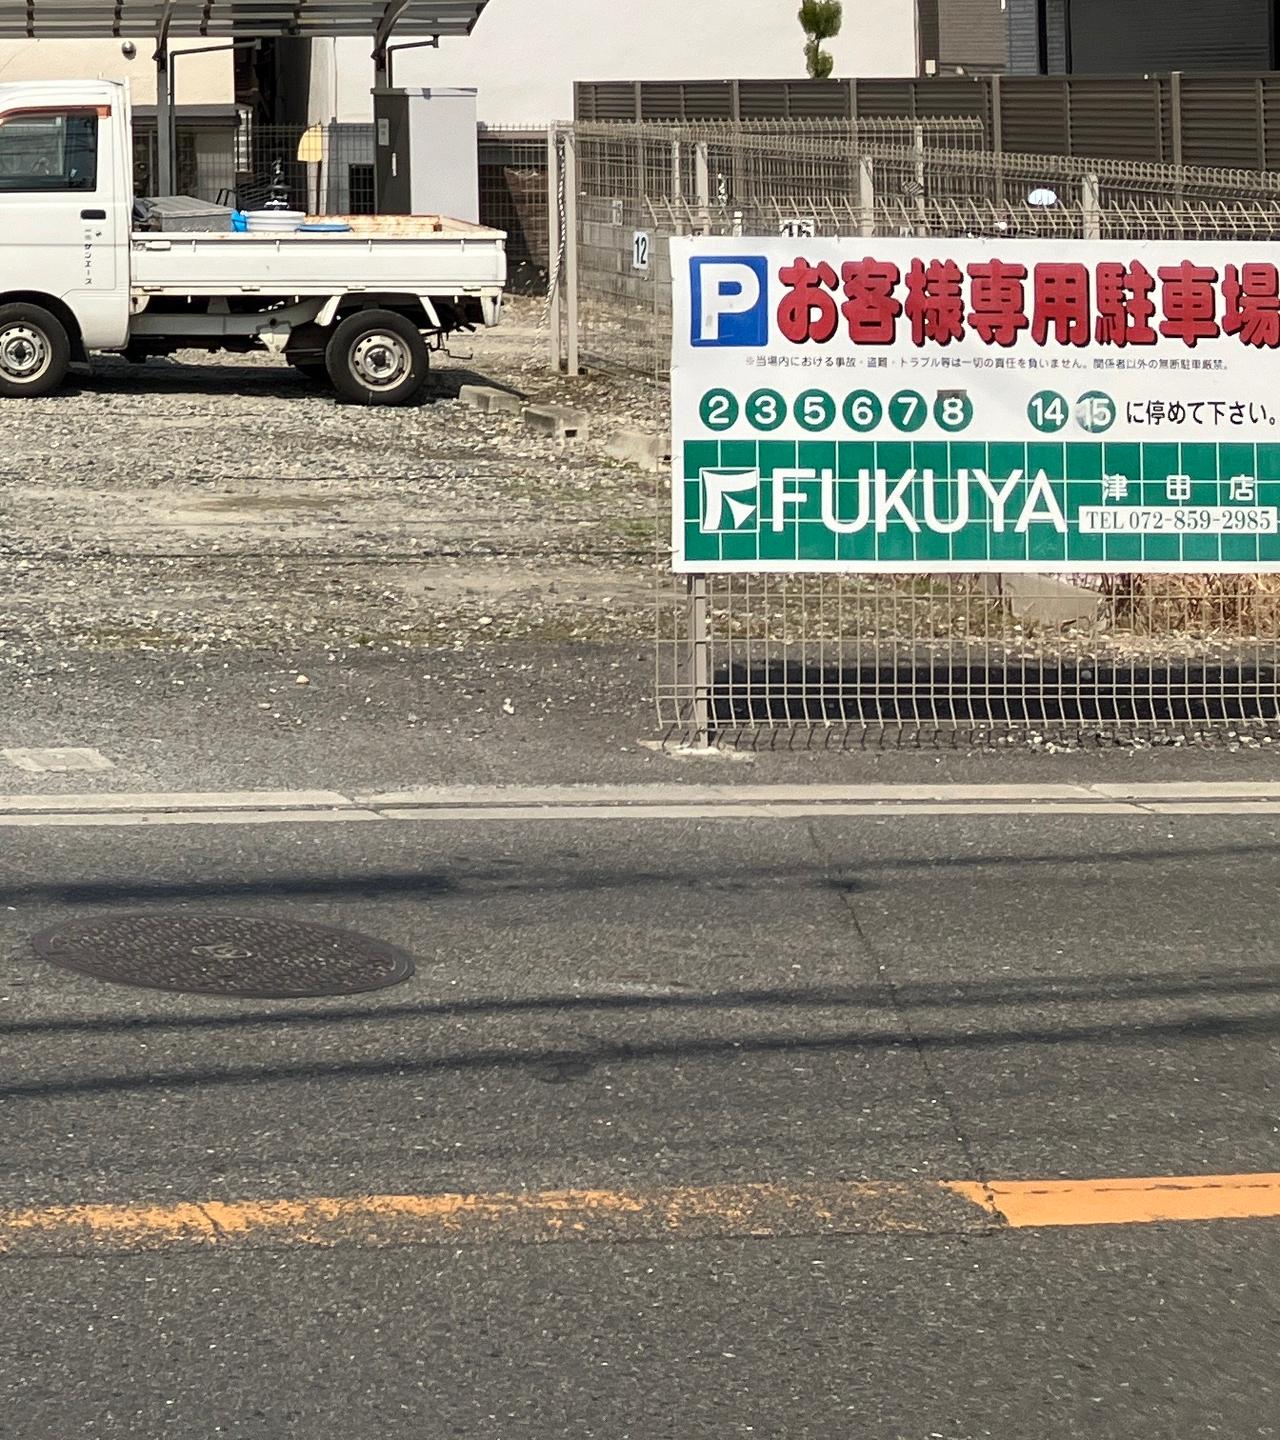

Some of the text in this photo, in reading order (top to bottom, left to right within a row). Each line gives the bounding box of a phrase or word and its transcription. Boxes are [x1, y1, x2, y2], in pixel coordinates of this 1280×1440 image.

[635, 236, 647, 264] 12
[700, 263, 760, 340] P
[777, 256, 1280, 348] お客様専用駐車場
[1031, 397, 1065, 427] 14
[1082, 397, 1112, 427] 15
[1126, 400, 1276, 426] に停めて下さい。
[772, 468, 1069, 534] FUKUYA
[1102, 473, 1255, 501] 津田店
[1086, 510, 1271, 530] TEL 072-859-2985
